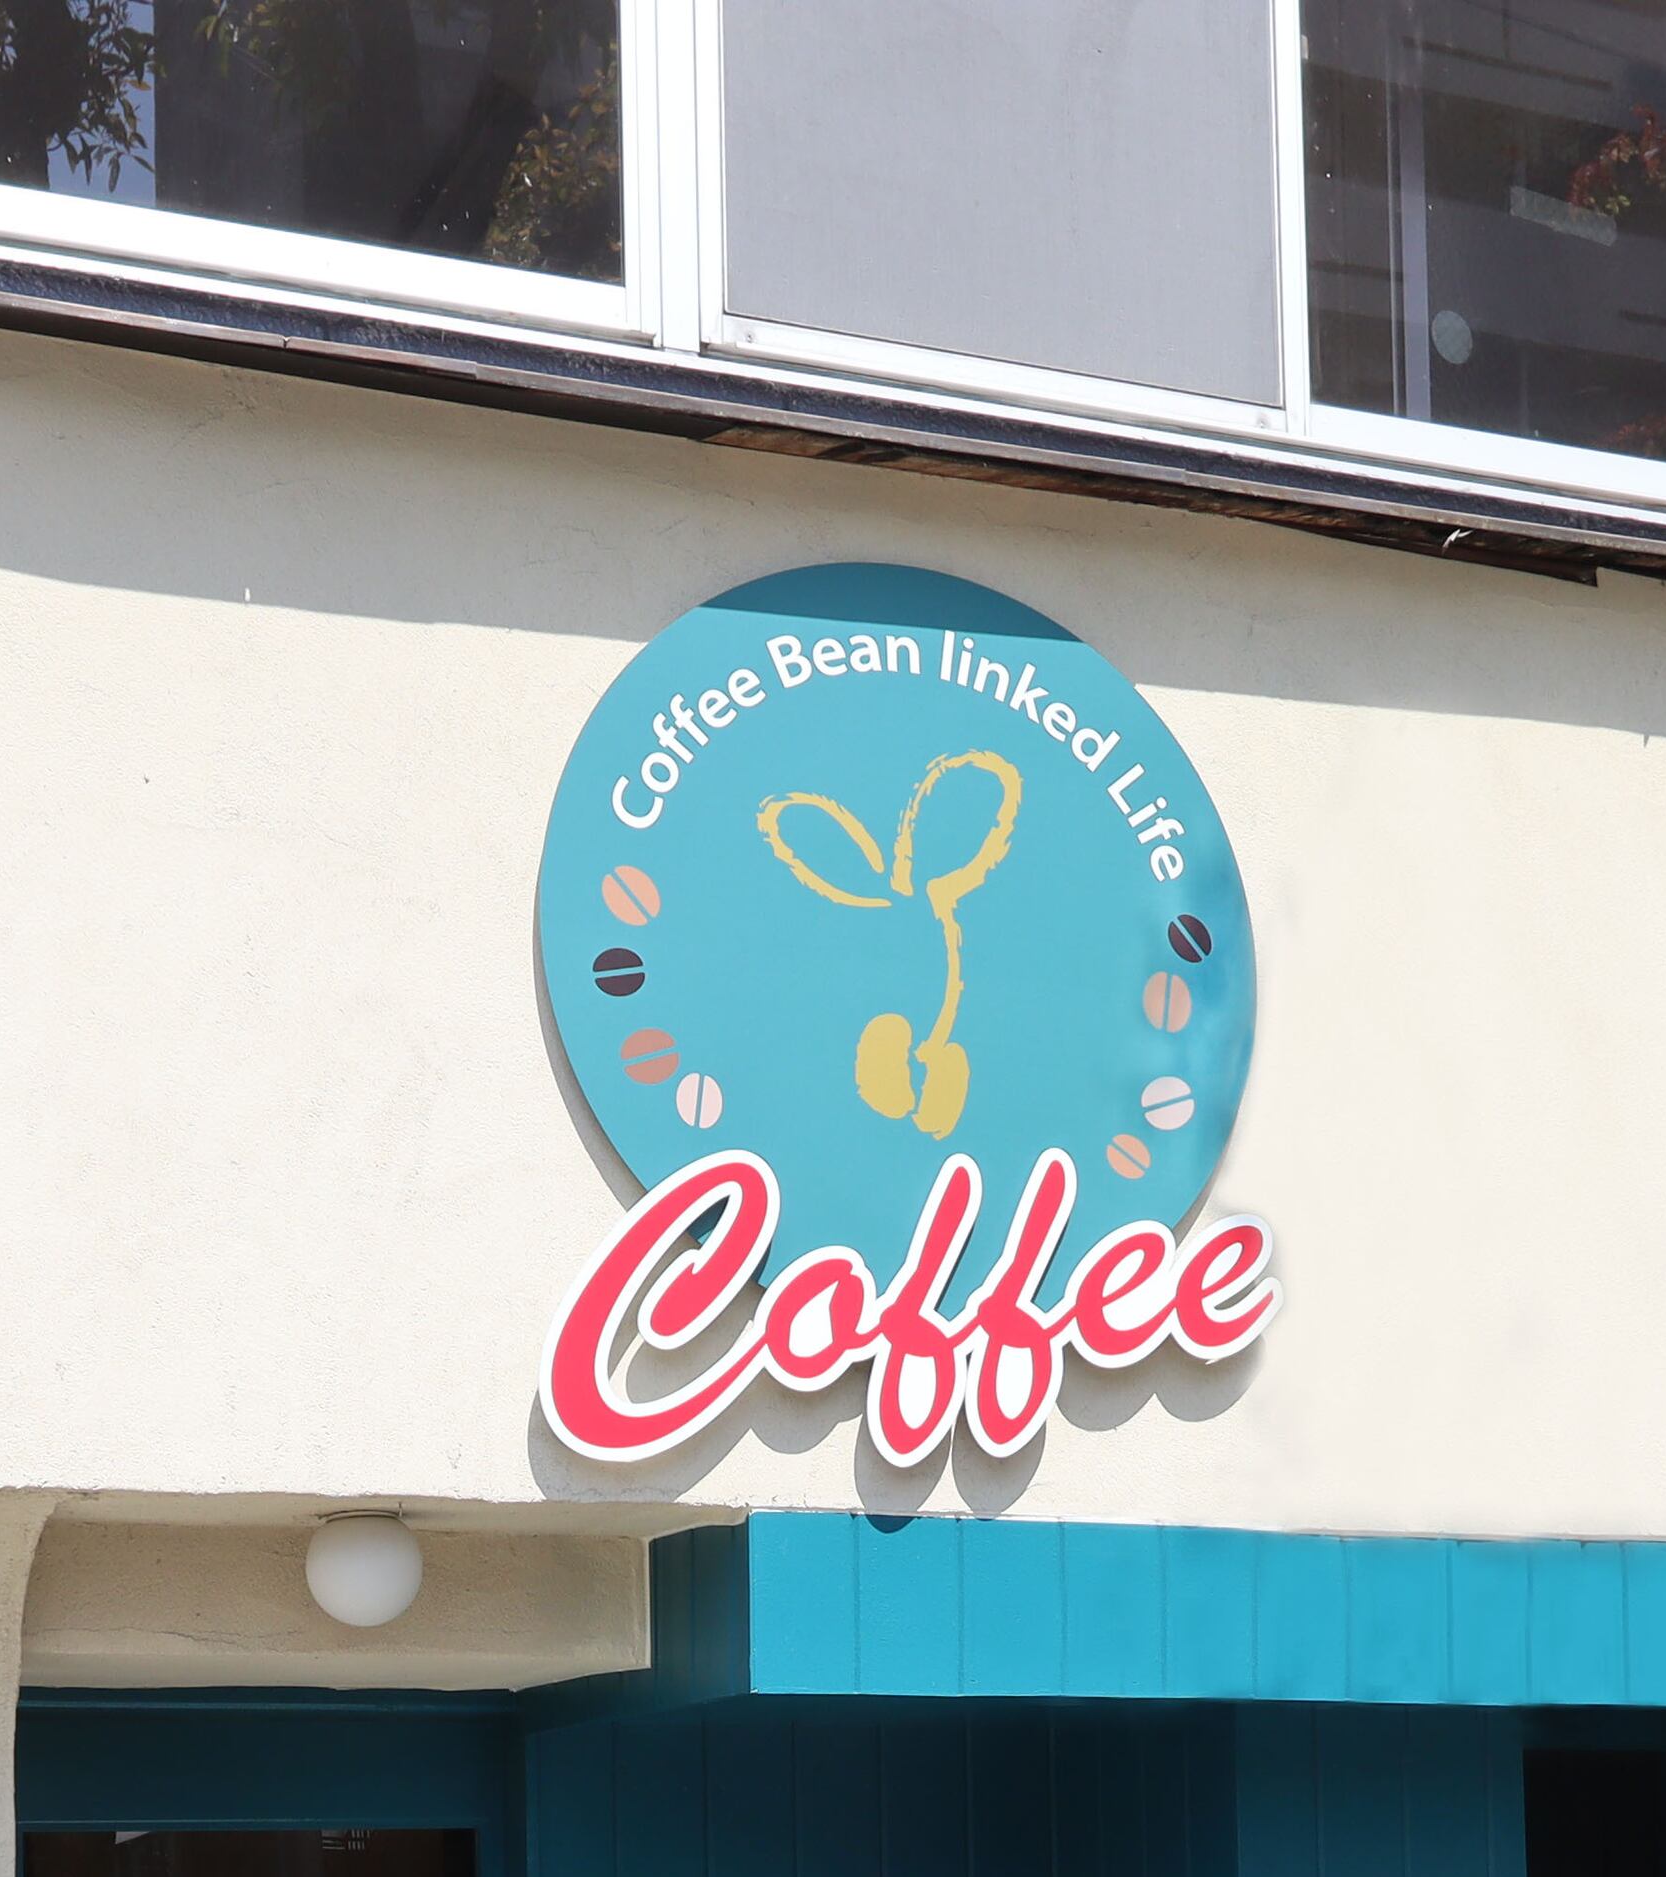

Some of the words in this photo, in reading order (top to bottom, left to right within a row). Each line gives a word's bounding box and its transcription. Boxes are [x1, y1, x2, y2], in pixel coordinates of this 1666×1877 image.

[610, 666, 767, 830] Coffee
[765, 632, 921, 689] Bean
[938, 629, 1121, 773] linked
[1105, 762, 1185, 883] Life
[545, 1152, 1279, 1462] Coffee
